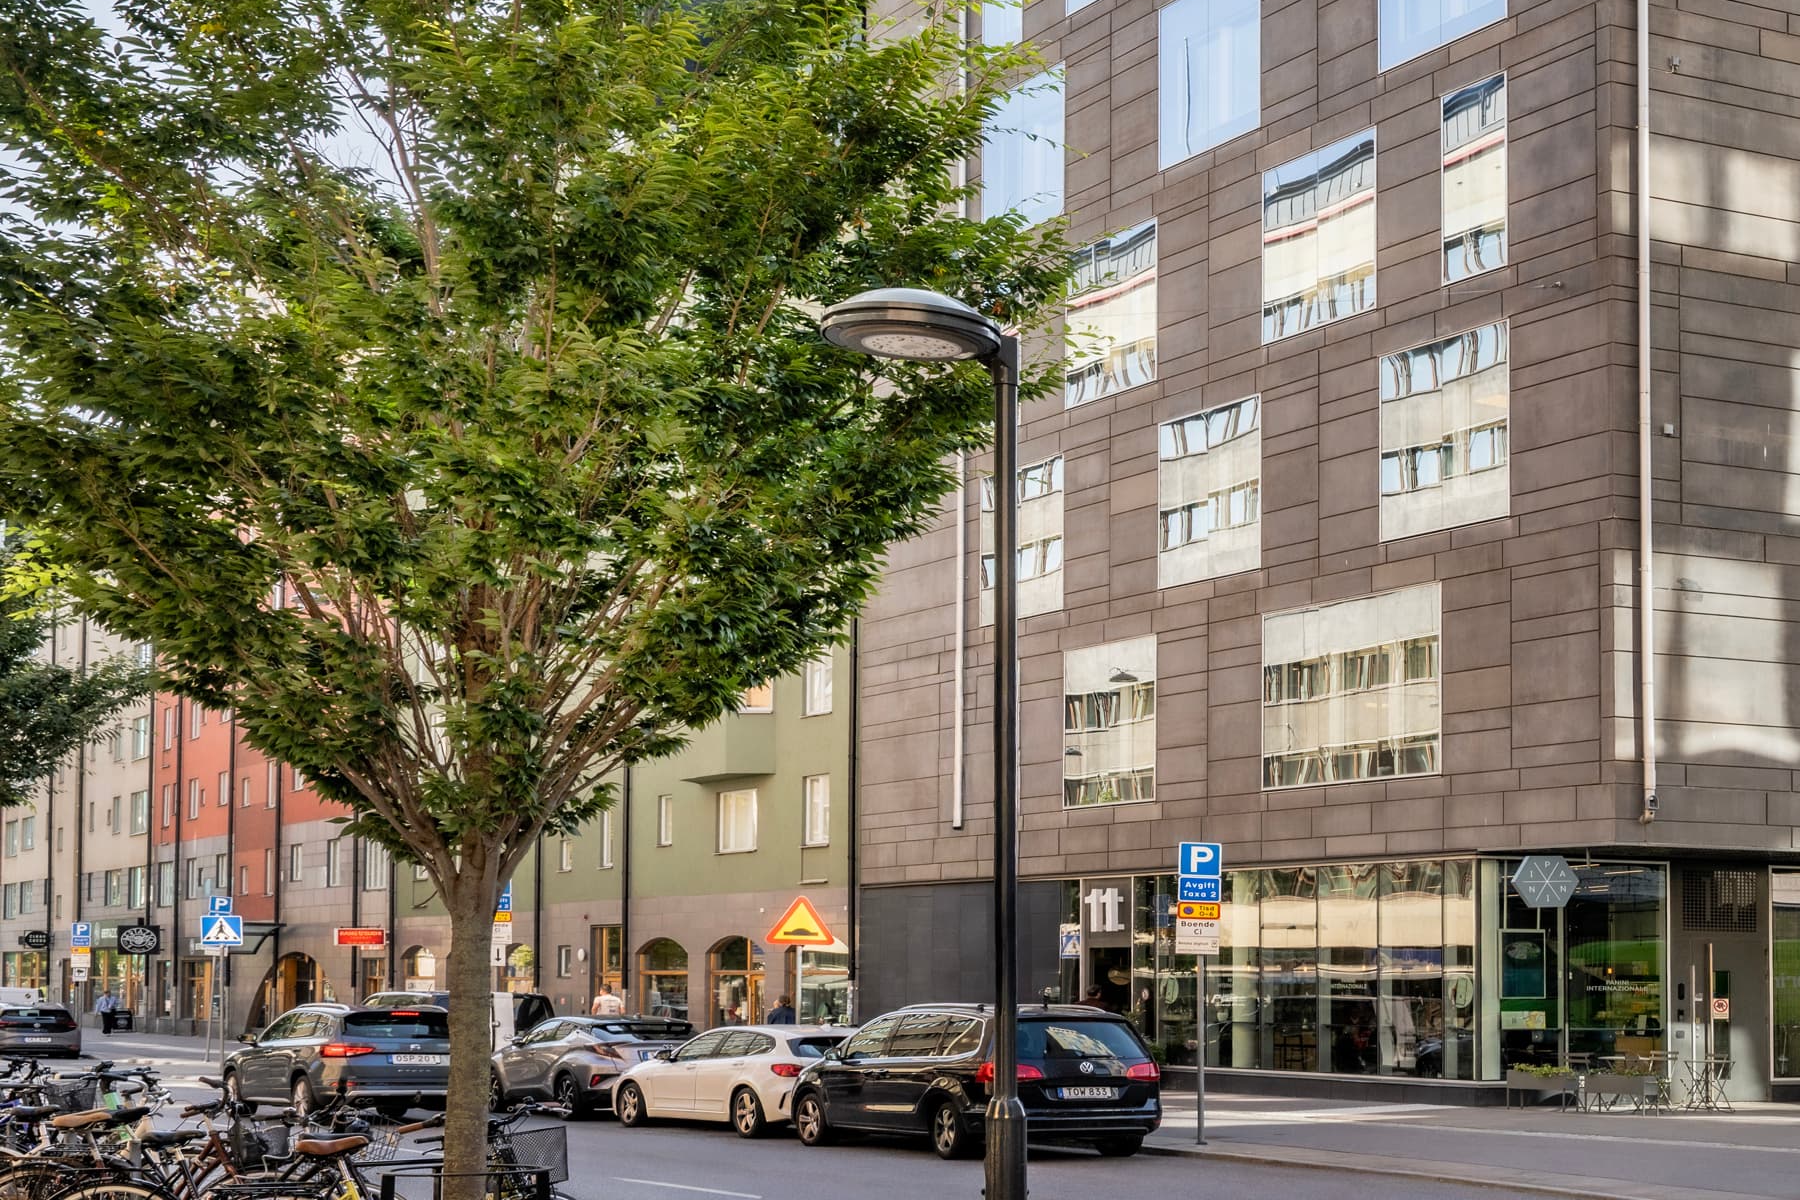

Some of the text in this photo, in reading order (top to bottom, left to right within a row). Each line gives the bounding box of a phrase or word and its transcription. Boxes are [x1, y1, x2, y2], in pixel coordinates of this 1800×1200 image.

[1191, 846, 1214, 873] P
[1185, 881, 1215, 890] Avgift
[215, 898, 228, 911] P
[76, 924, 88, 936] P
[1066, 1087, 1107, 1096] TOW 833
